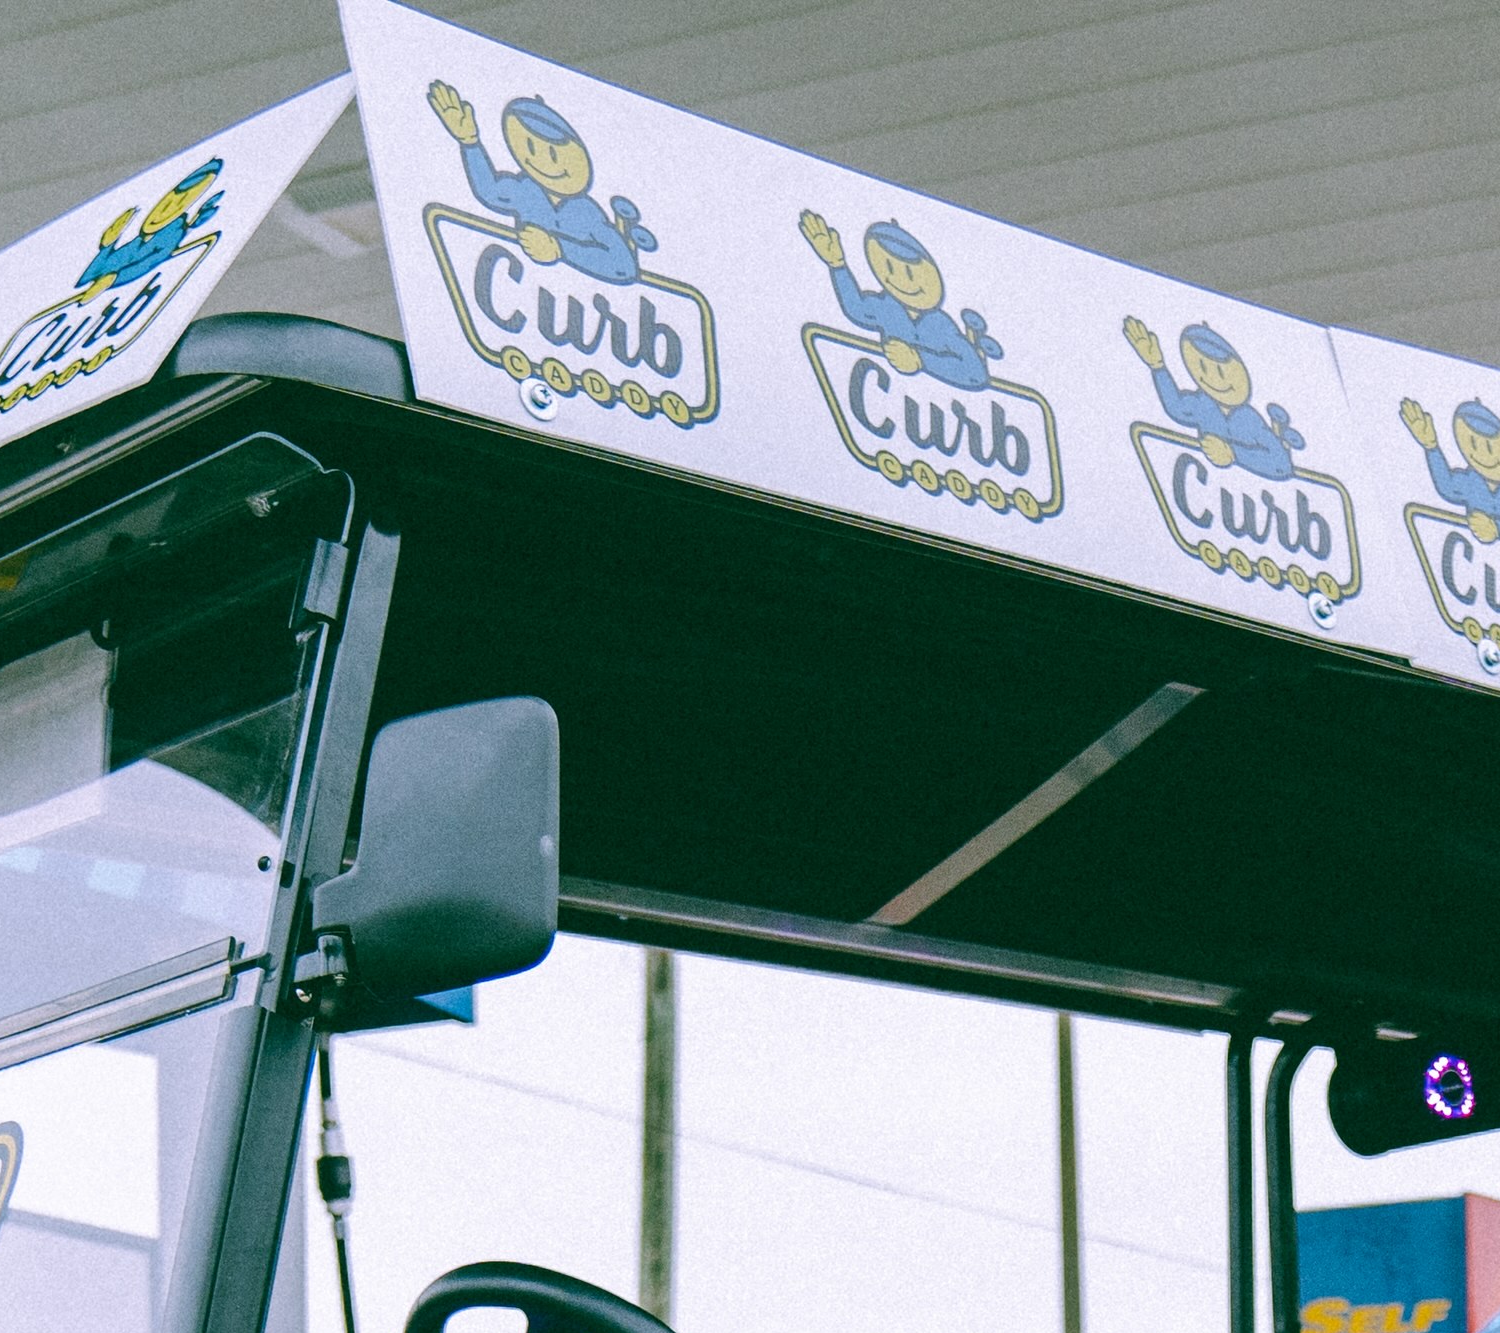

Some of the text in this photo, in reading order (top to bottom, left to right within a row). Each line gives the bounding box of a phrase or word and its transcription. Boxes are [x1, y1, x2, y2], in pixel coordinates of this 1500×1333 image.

[474, 243, 683, 379] Curb
[505, 351, 686, 421] CADDY
[849, 357, 1030, 477] Curb
[880, 455, 1036, 515] CADDY
[1172, 452, 1332, 561] Curb
[1202, 544, 1338, 599] CADDY
